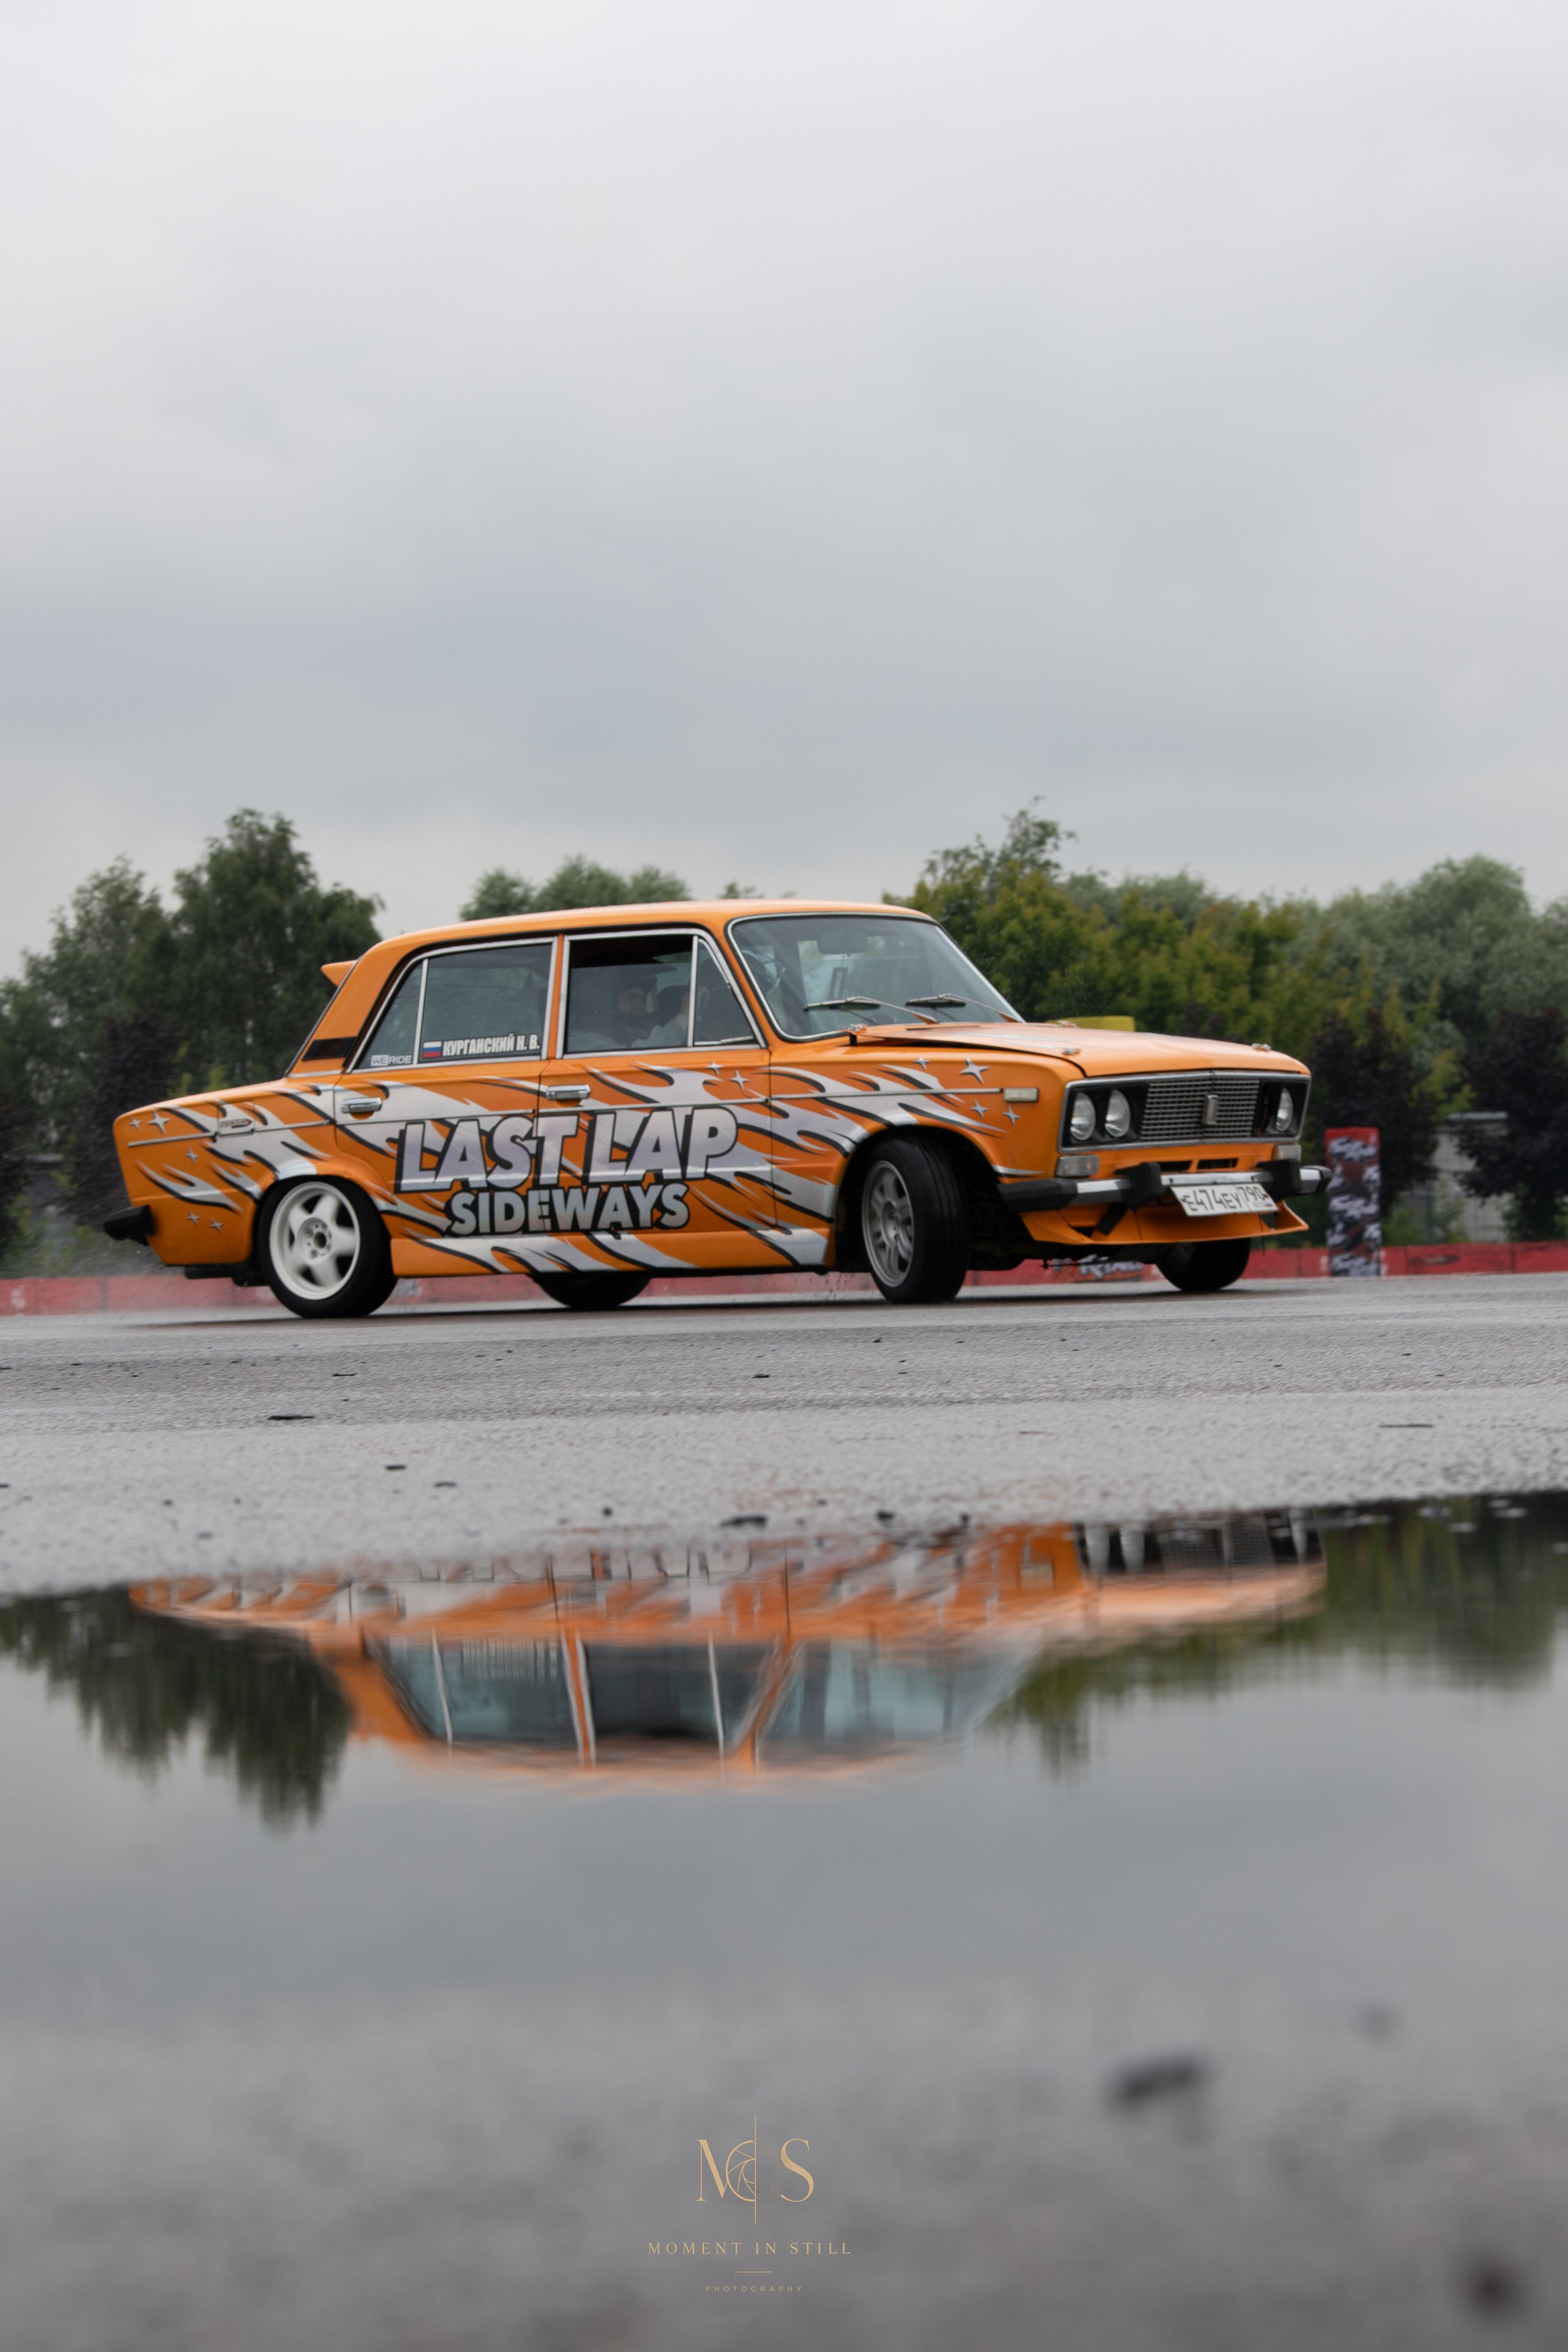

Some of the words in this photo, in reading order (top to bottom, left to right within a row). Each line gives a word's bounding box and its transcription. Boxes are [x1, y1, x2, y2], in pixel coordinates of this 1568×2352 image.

[442, 1033, 514, 1057] КУРГАНСКИЙ
[394, 1112, 579, 1194] LAST
[581, 1105, 737, 1185] LAP
[444, 1182, 690, 1236] SIDEWAYS
